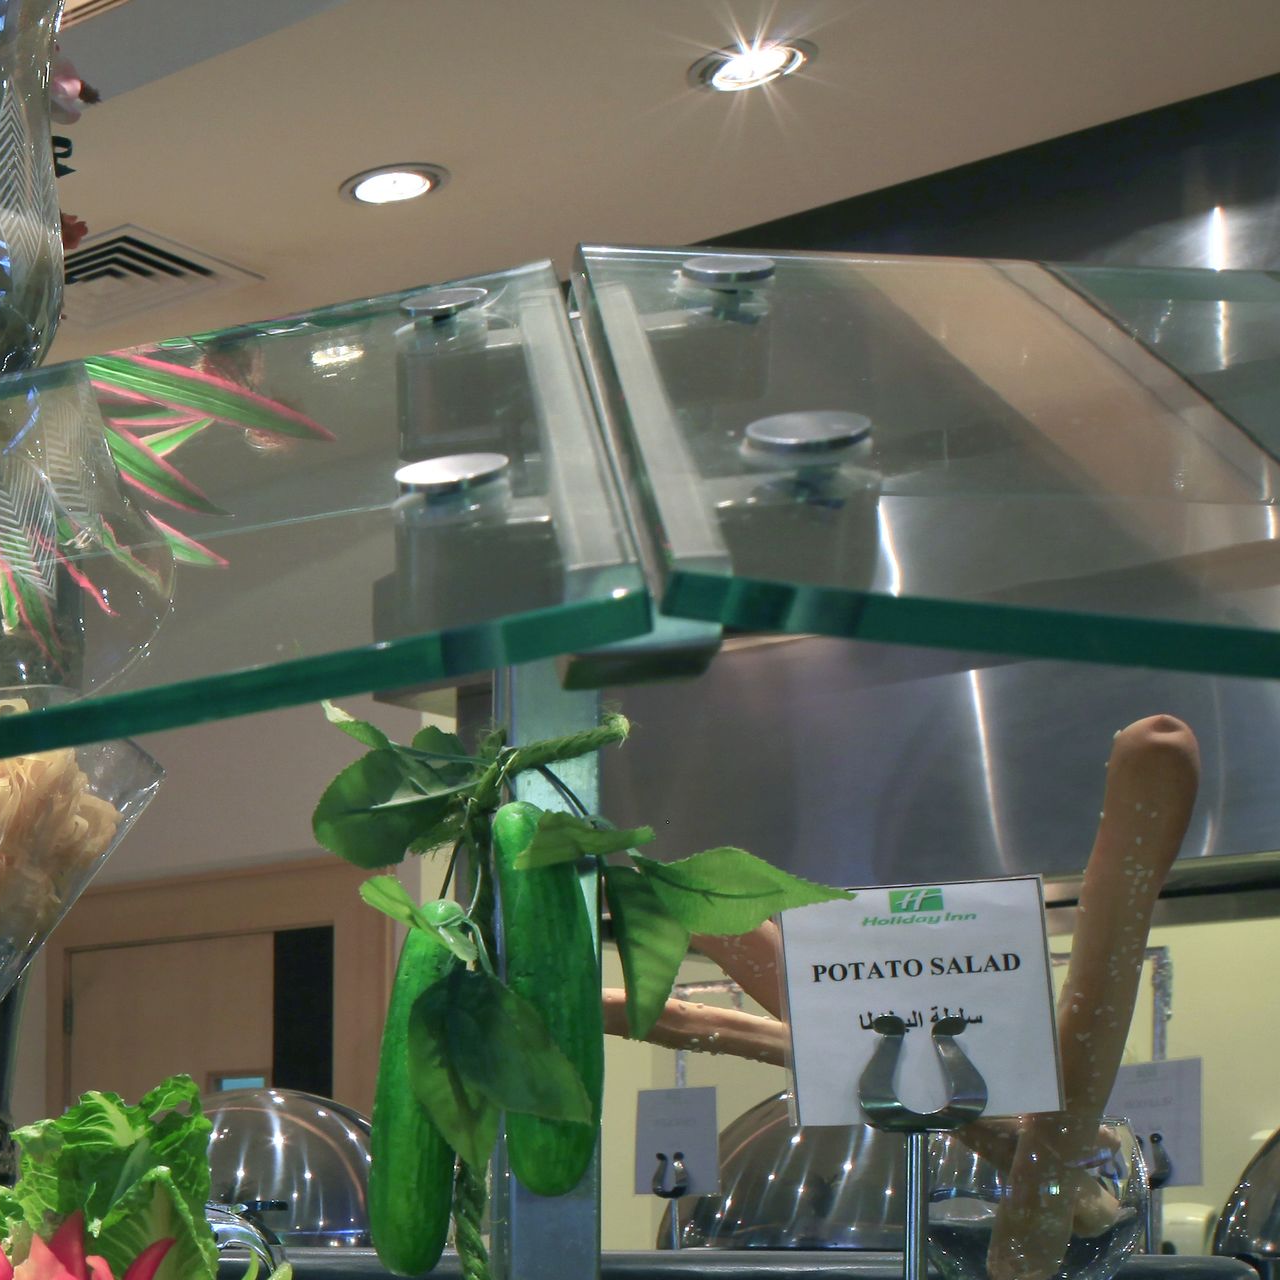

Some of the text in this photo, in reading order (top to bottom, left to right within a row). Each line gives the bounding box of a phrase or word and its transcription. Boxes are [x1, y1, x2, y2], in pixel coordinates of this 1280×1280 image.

[861, 911, 978, 927] Holiday Inn
[811, 952, 1021, 983] POTATO SALAD
